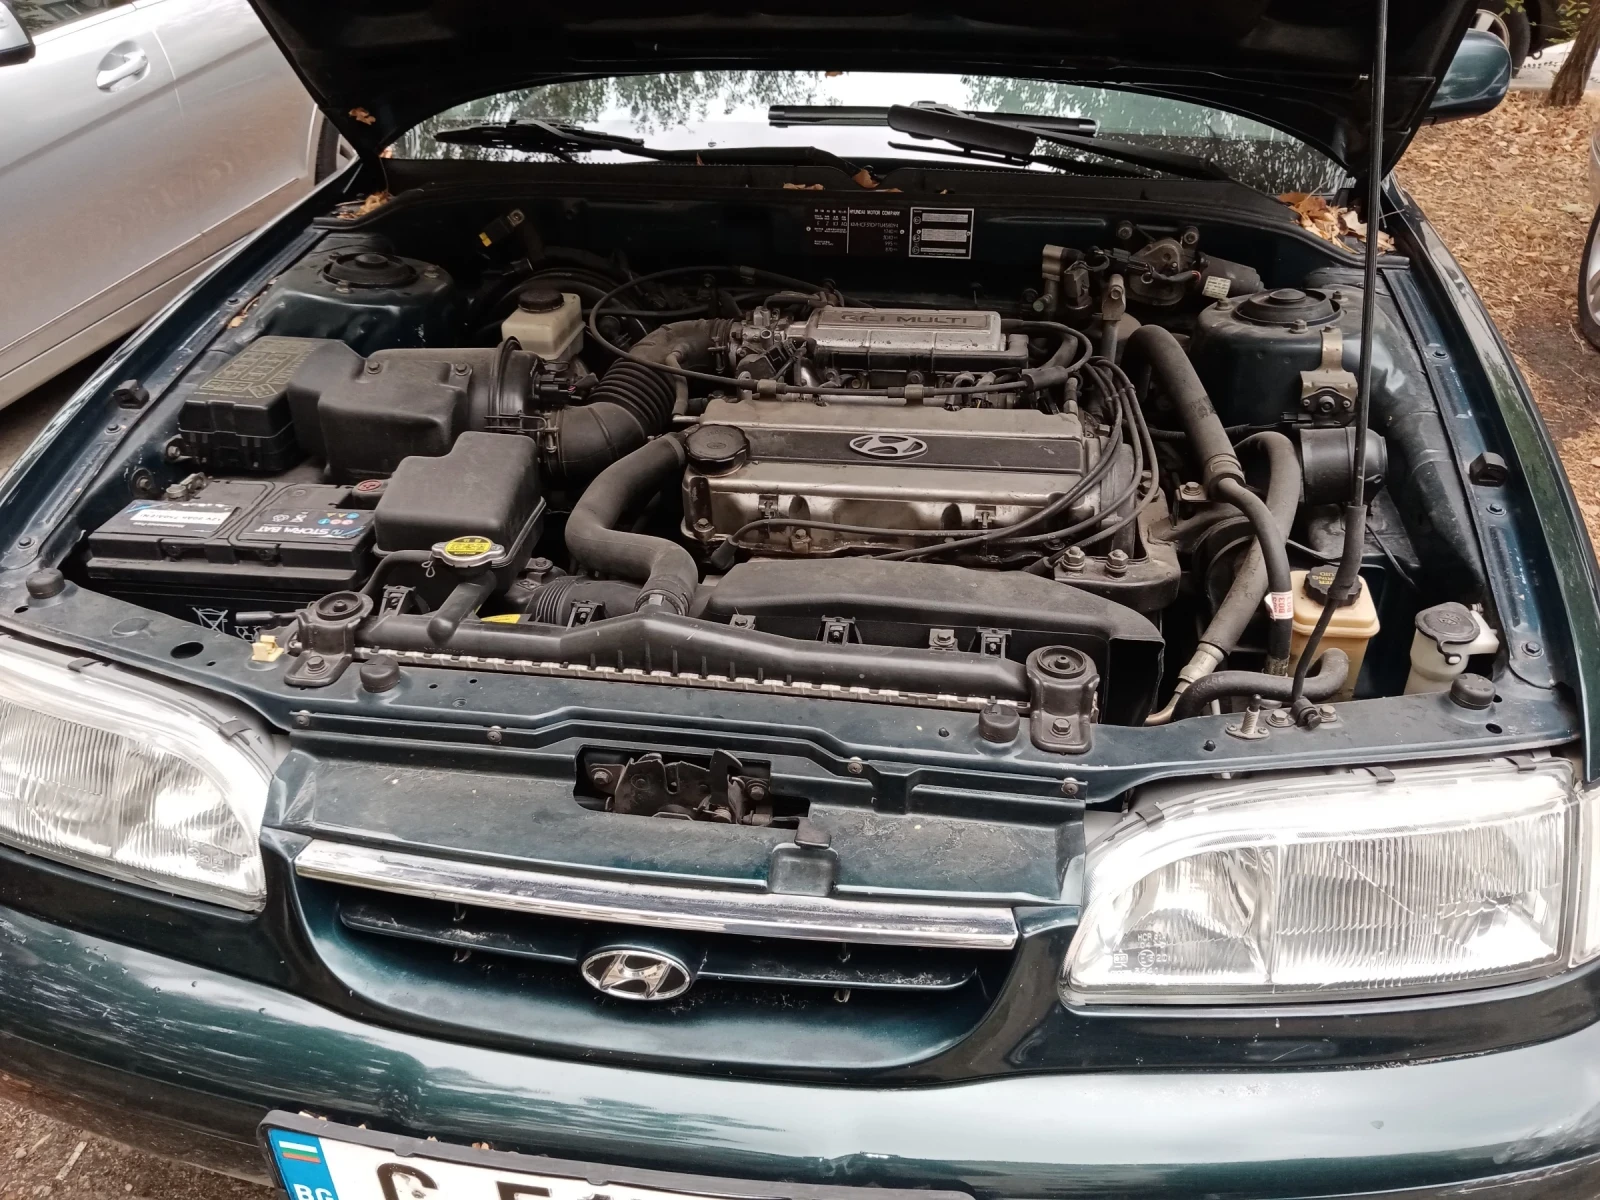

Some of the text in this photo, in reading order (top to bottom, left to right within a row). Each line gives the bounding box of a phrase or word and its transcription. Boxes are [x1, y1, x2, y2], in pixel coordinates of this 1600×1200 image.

[897, 314, 967, 324] MULTI
[254, 525, 282, 533] BAT
[1137, 932, 1153, 942] HCR
